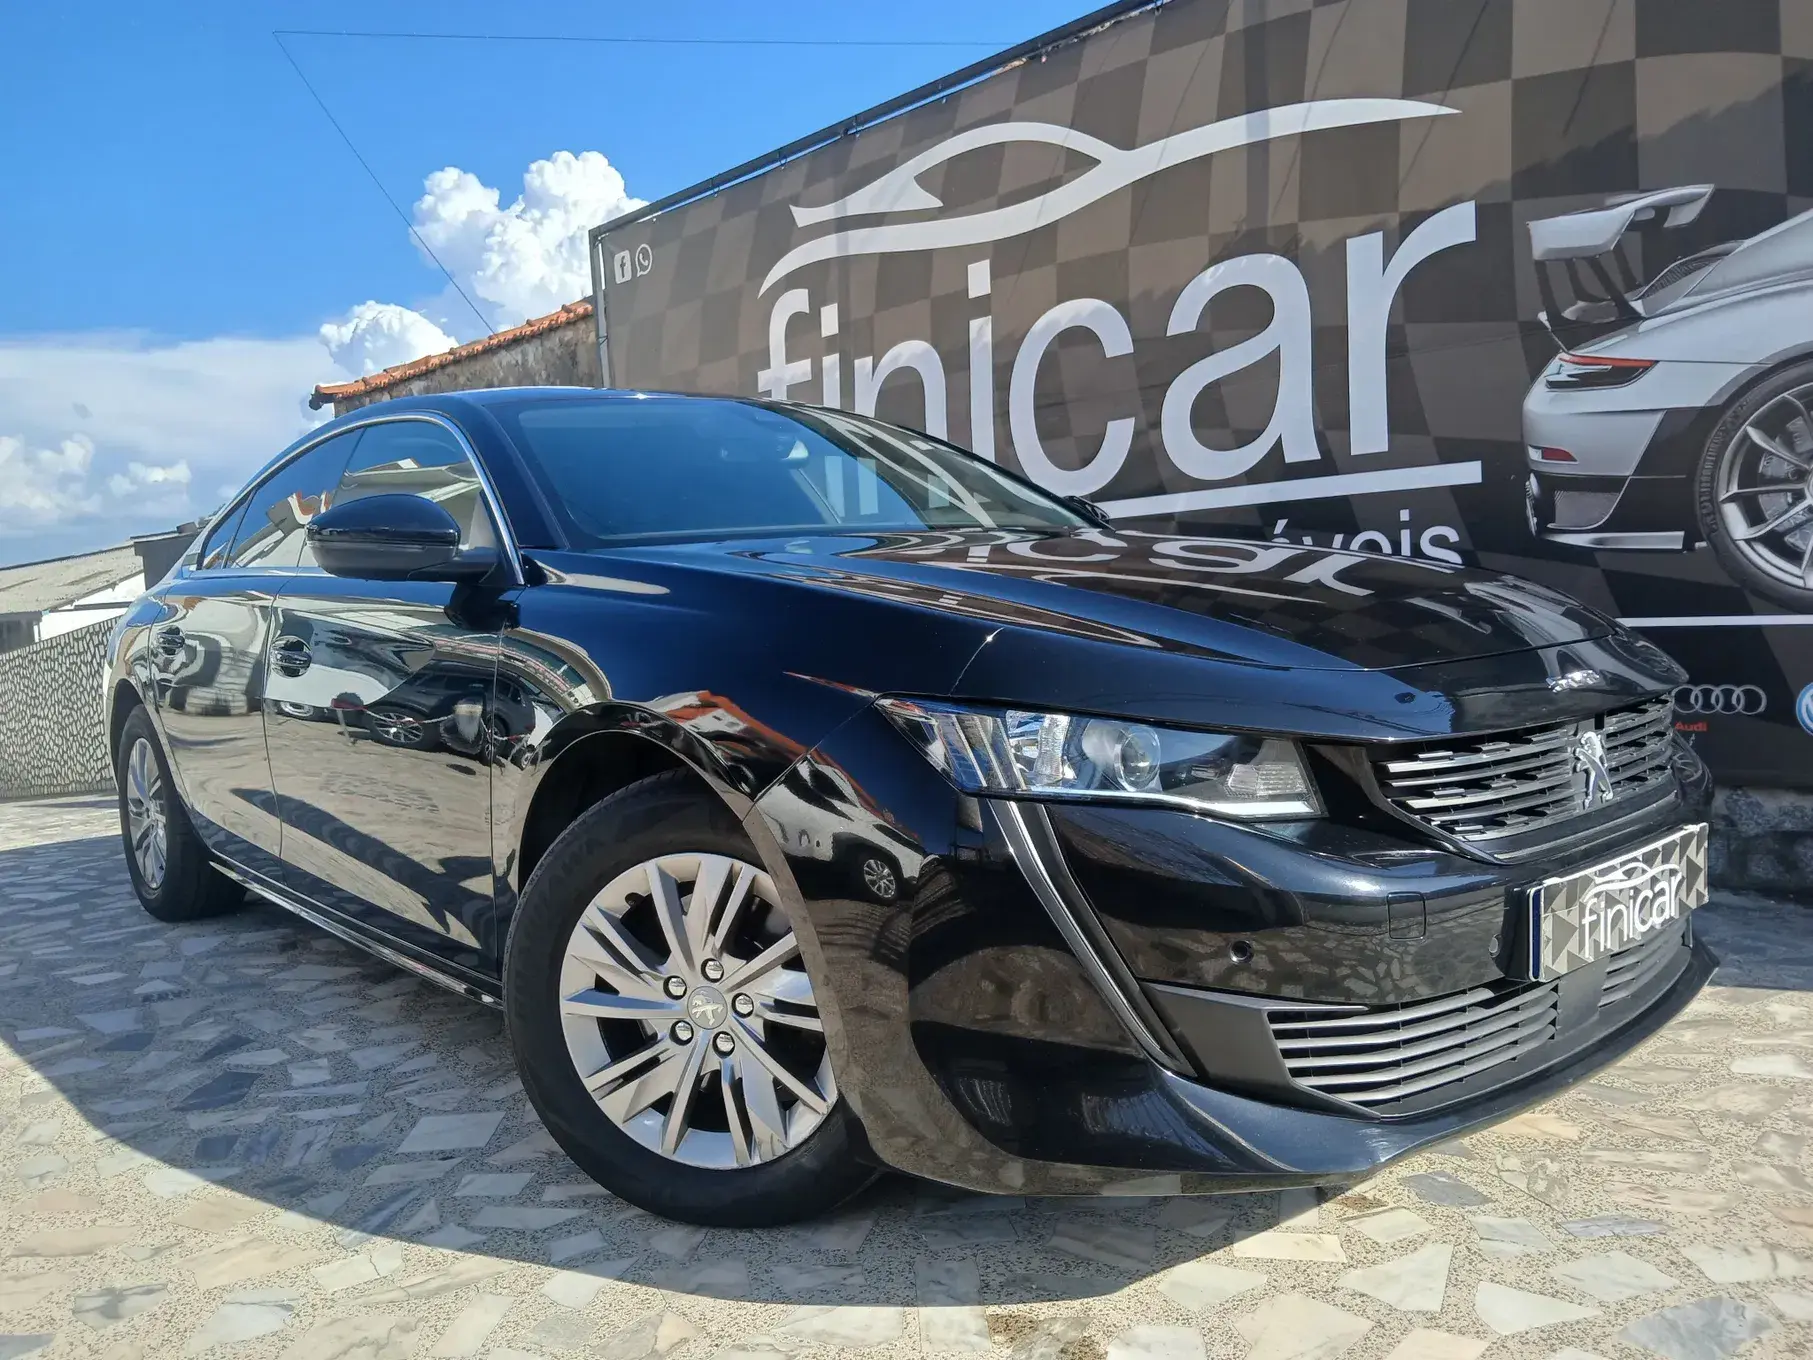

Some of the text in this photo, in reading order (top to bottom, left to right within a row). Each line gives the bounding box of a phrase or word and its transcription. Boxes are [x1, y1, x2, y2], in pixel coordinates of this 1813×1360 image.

[757, 200, 1476, 497] finicar
[1674, 721, 1708, 732] Audi
[1582, 871, 1682, 959] finicar
